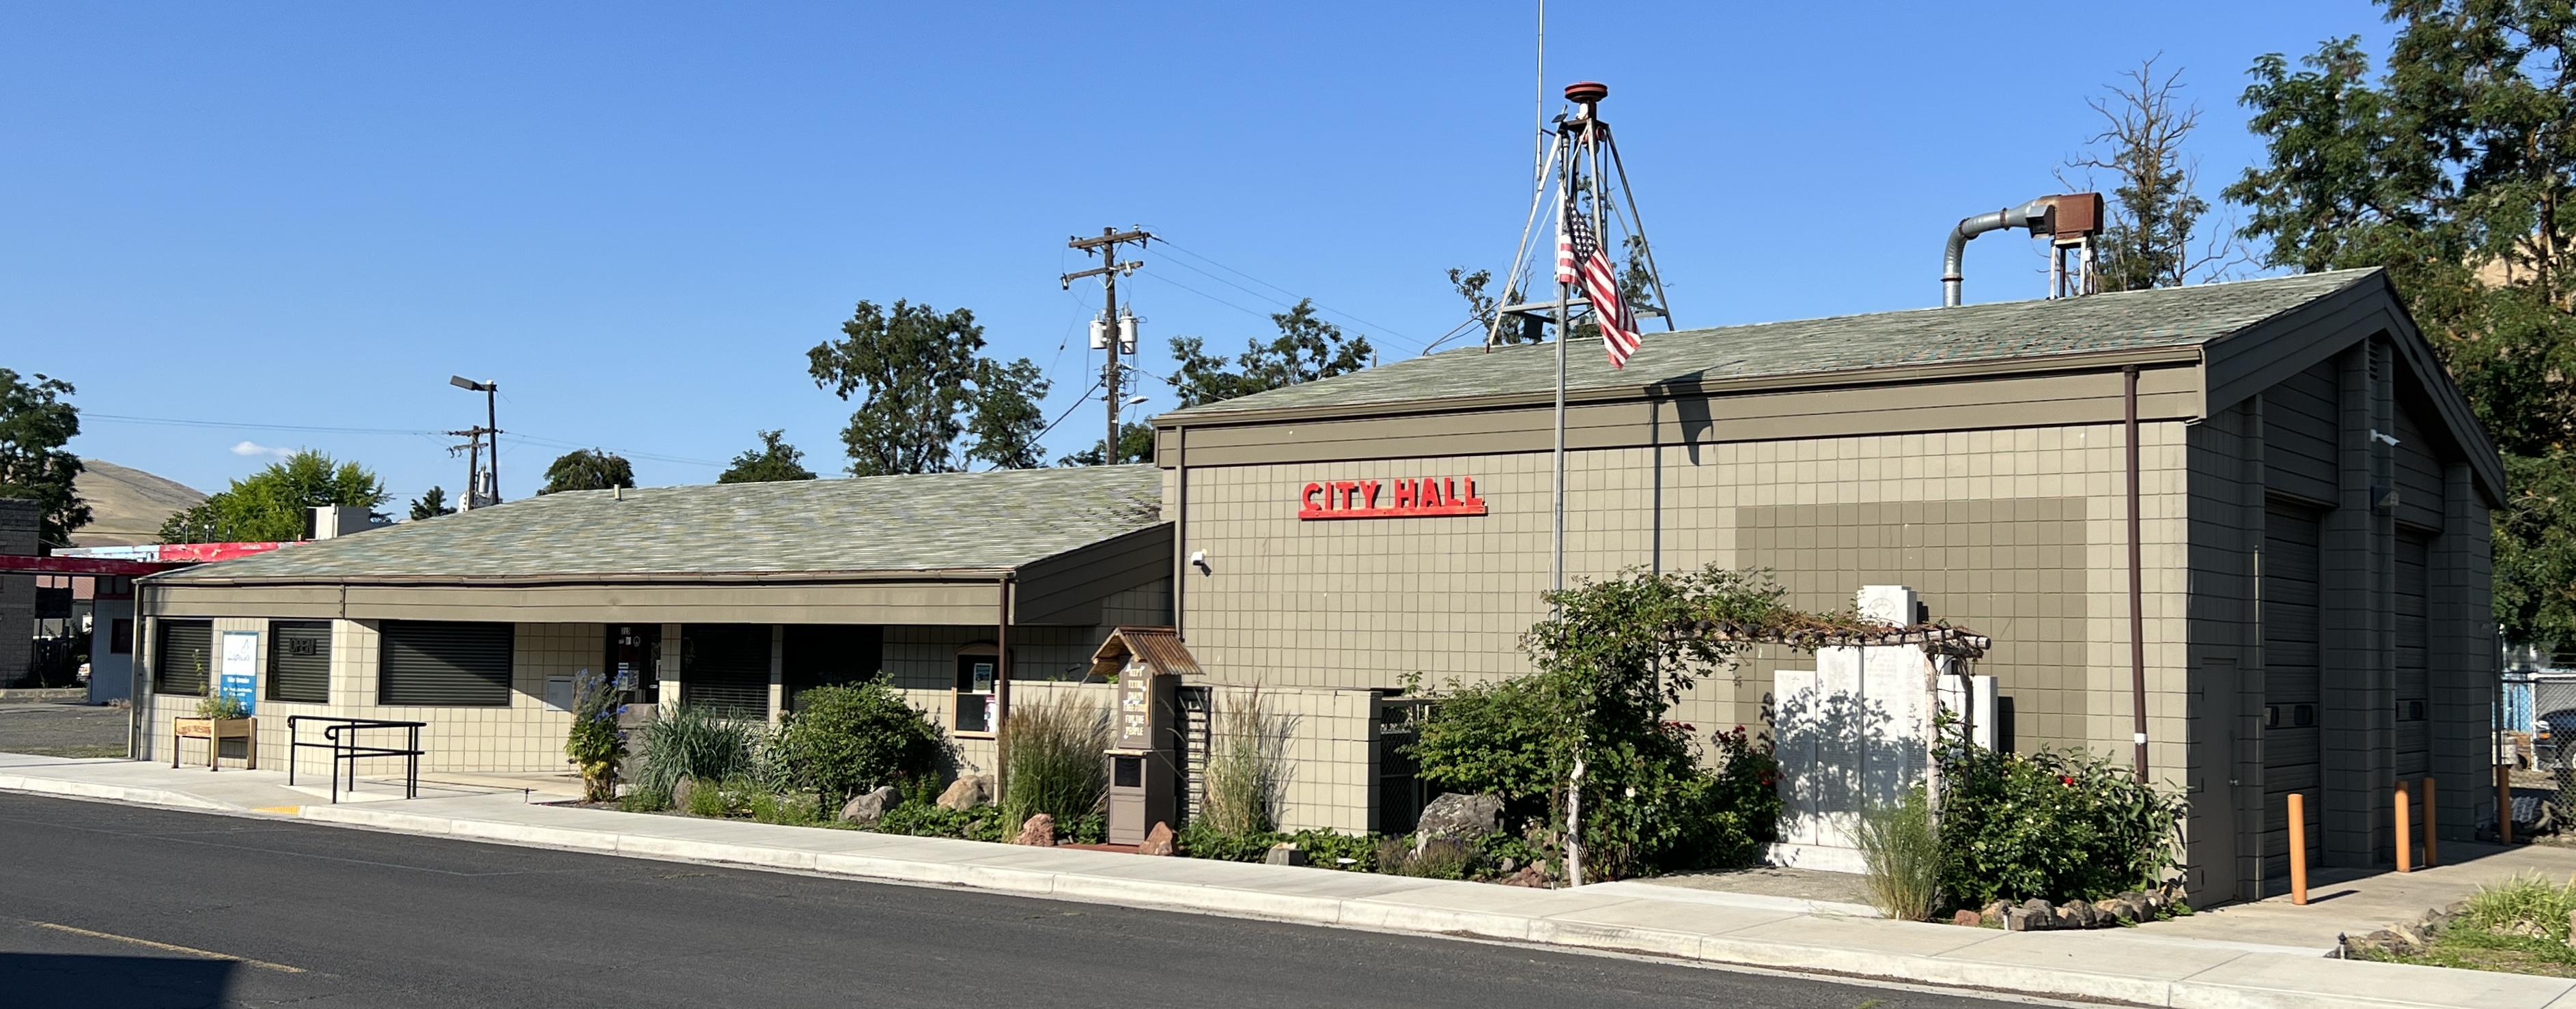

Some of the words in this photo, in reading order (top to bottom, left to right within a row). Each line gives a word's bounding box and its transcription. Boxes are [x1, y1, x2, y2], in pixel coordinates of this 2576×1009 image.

[1302, 480, 1378, 511] CITY
[1395, 476, 1483, 508] HALL
[290, 638, 313, 654] OPEN
